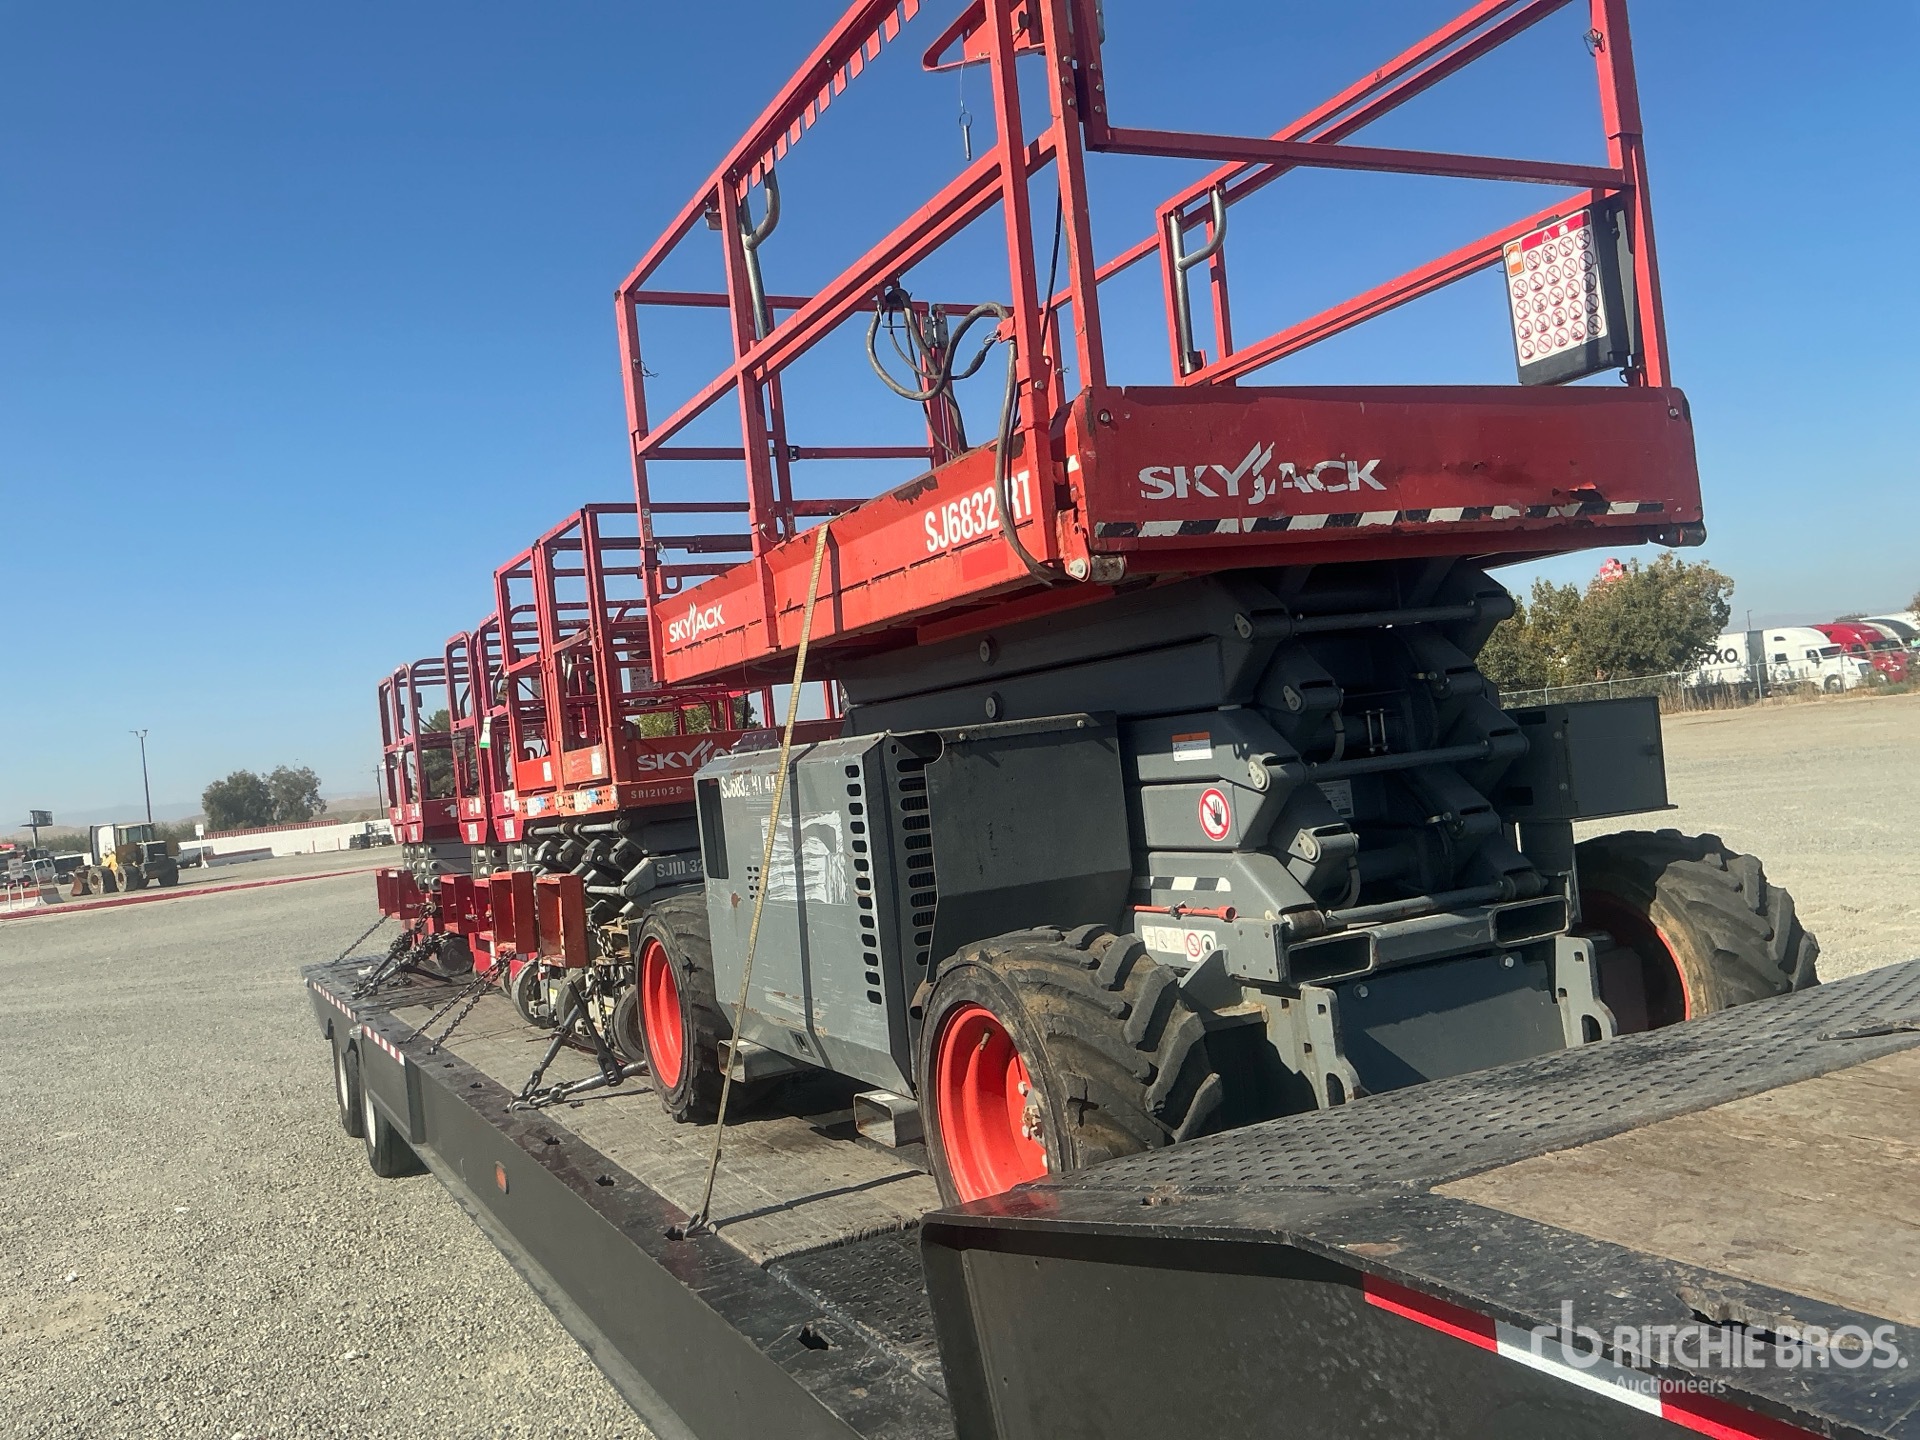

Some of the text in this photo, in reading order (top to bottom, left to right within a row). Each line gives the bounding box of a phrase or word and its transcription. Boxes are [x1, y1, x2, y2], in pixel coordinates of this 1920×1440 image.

[1138, 441, 1387, 505] SKYJACK
[924, 470, 1032, 553] SJ6832 RT
[668, 601, 726, 643] SKYJACK
[1699, 647, 1738, 665] RXO
[656, 858, 704, 878] SJIII 32
